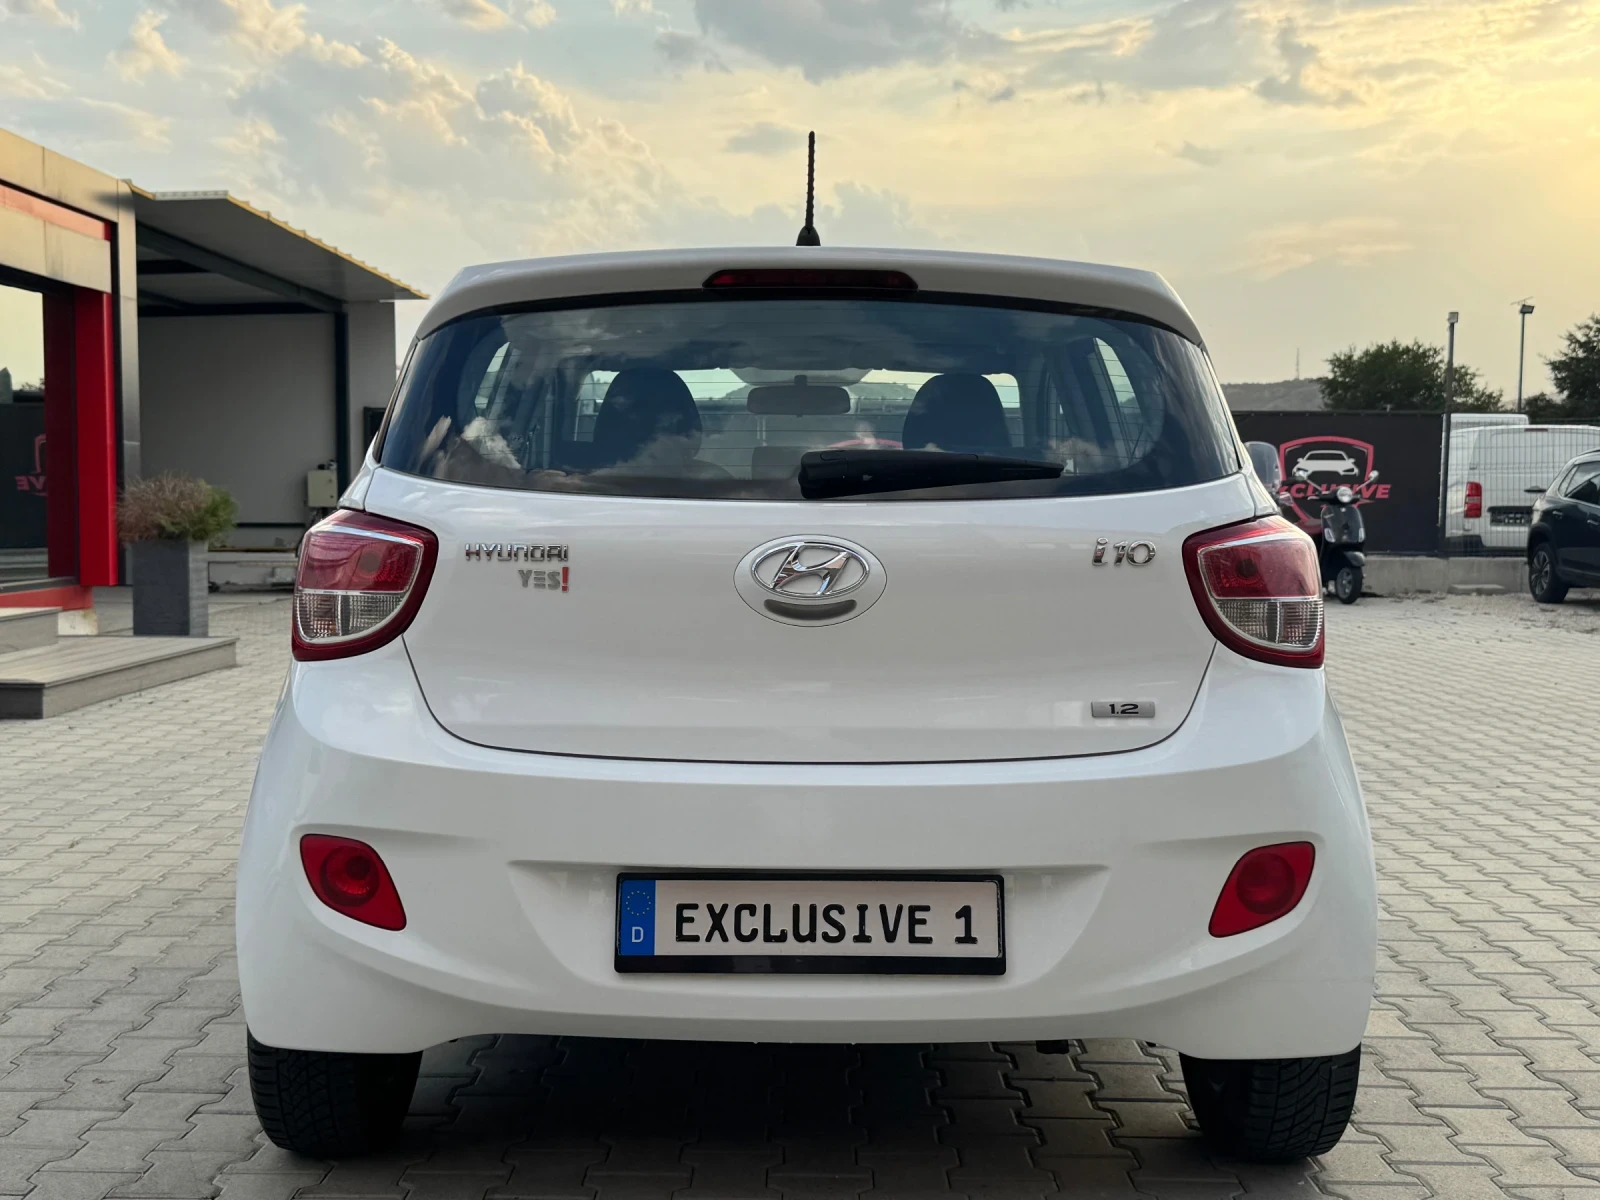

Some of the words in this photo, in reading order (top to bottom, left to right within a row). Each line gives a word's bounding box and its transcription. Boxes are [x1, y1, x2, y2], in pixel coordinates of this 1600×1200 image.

[465, 543, 569, 562] HYUNDAI
[1092, 537, 1157, 567] i10
[518, 566, 570, 593] YES!
[1109, 703, 1139, 715] 1.2
[631, 926, 644, 943] D
[675, 902, 933, 945] EXCLUSIVE
[954, 905, 979, 945] 1
